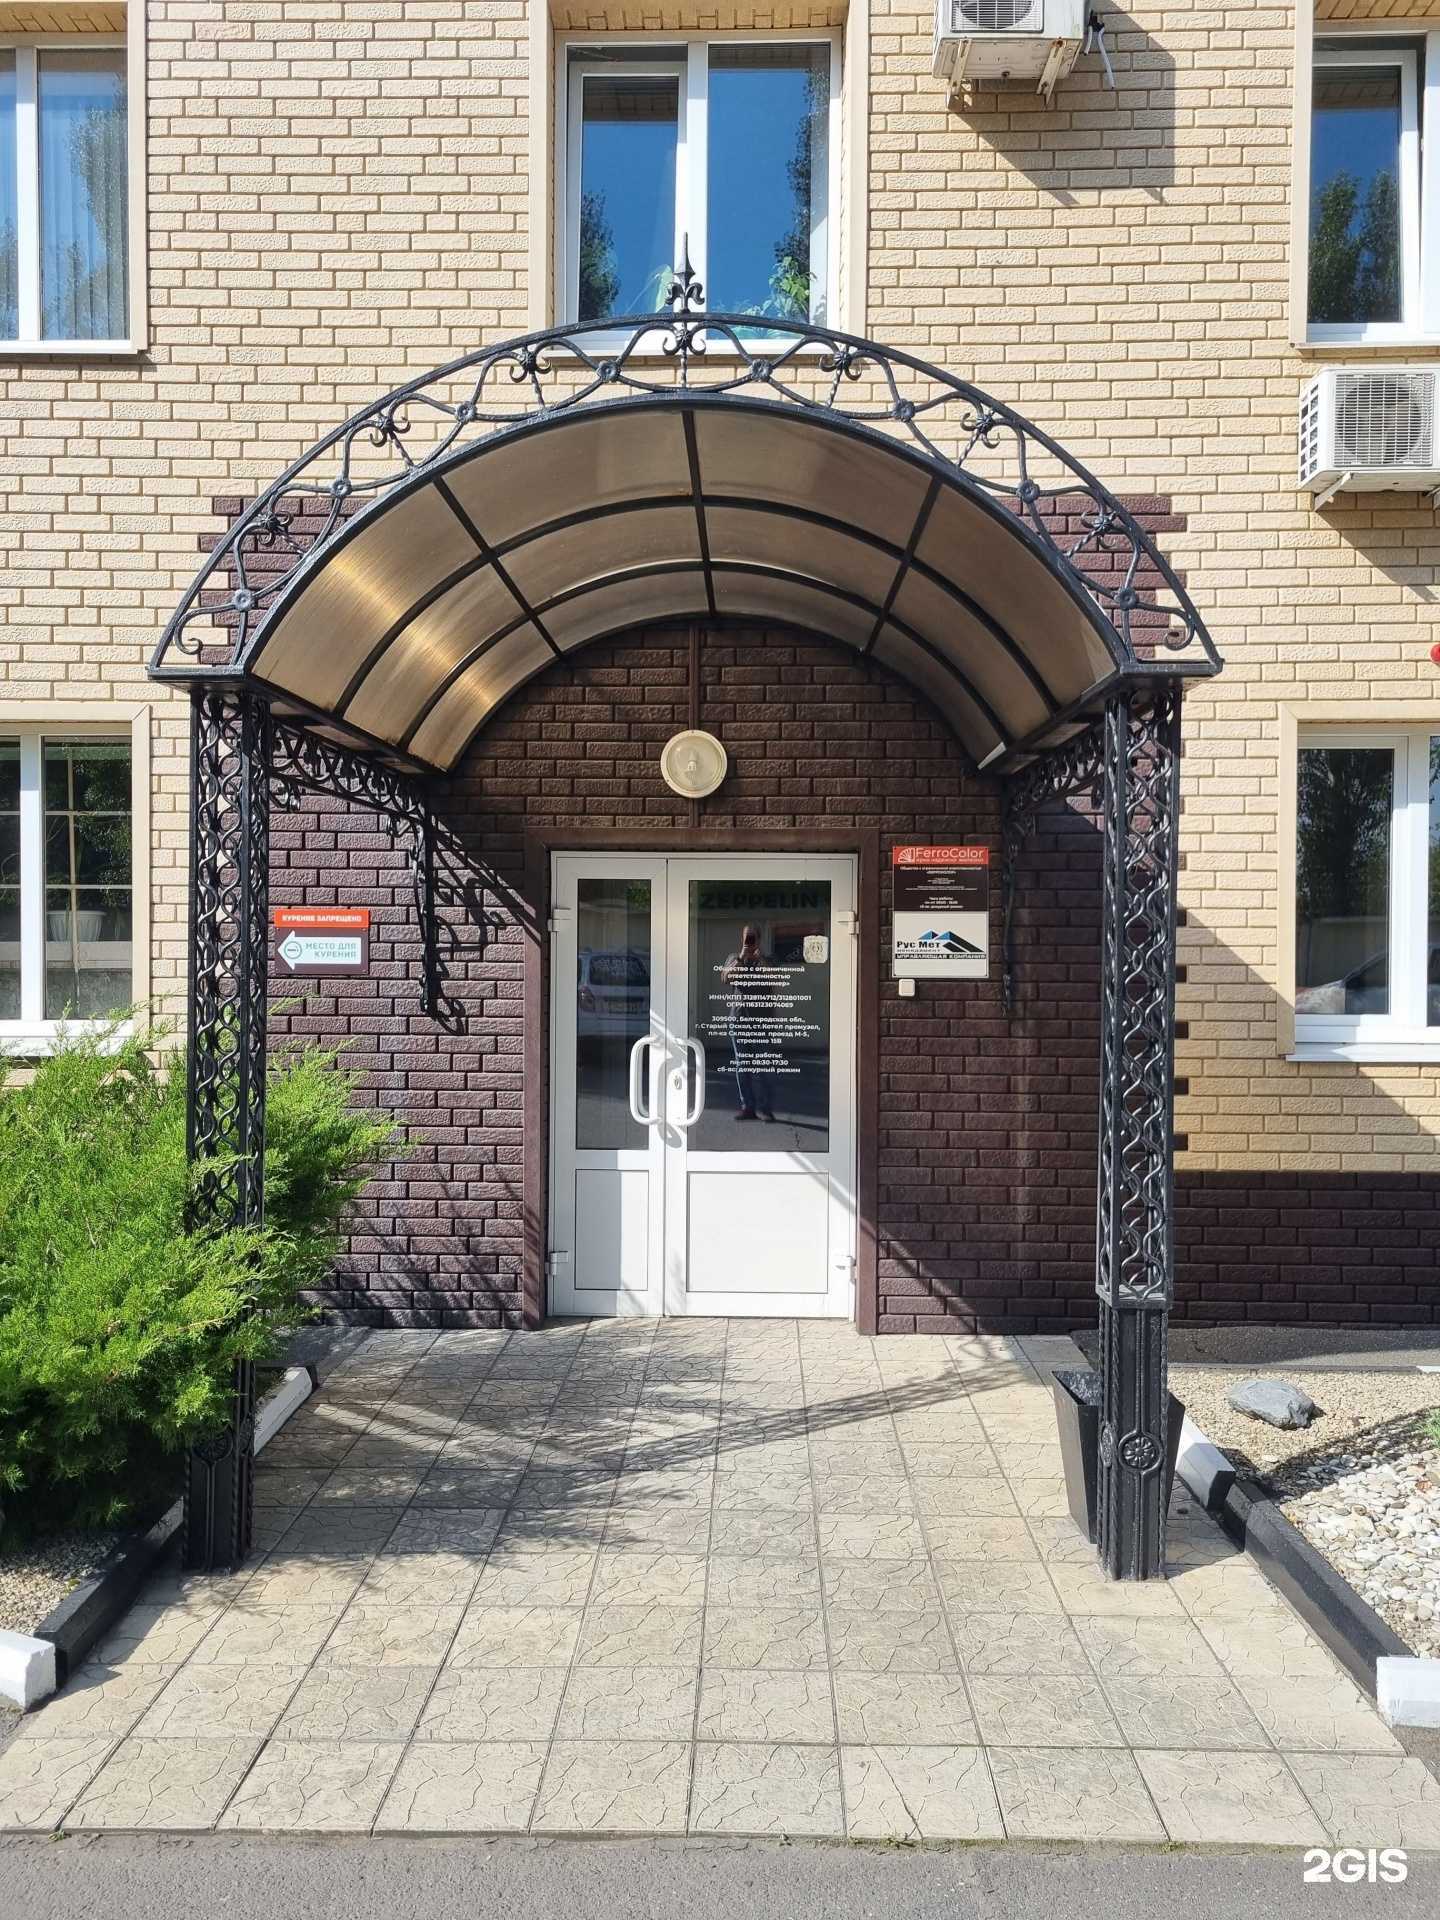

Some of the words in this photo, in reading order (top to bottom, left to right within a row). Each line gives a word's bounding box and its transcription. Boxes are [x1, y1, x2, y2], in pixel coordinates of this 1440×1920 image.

[916, 847, 984, 858] FerroColor
[700, 892, 818, 909] ZEPPELIN
[282, 914, 315, 922] КУРЕНИЕ
[305, 942, 335, 950] МЕСТО
[337, 942, 357, 951] ДЛЯ
[896, 941, 916, 949] Рус
[918, 941, 940, 949] Мет
[314, 950, 357, 958] КУРЕНИЯ
[713, 965, 749, 973] Общество
[739, 1016, 788, 1024] Белгородская
[728, 1030, 766, 1038] Складская
[738, 1066, 775, 1074] дежурный
